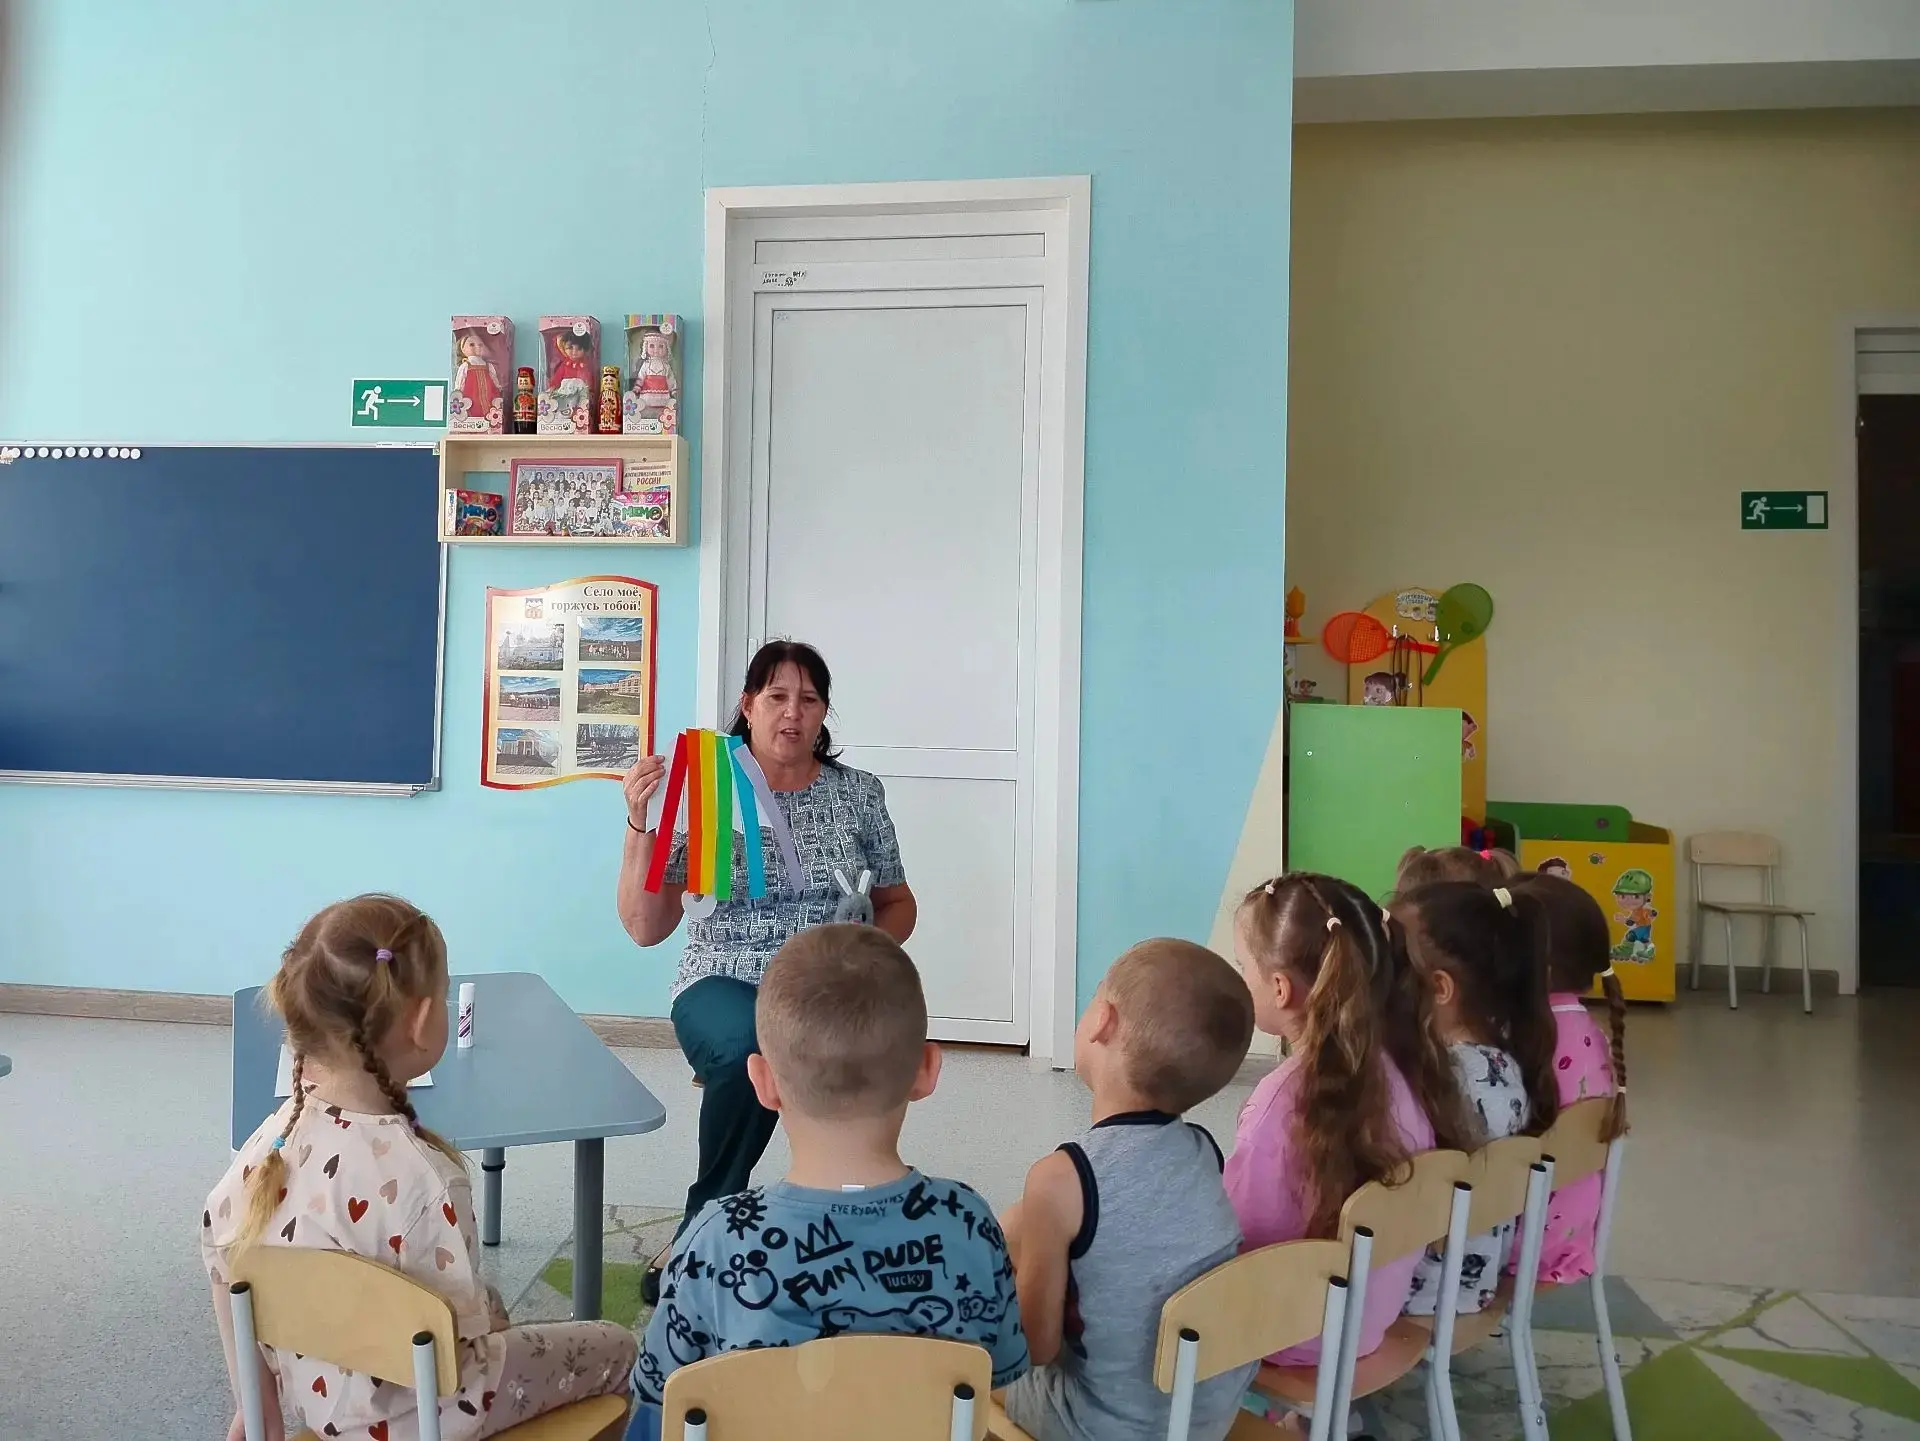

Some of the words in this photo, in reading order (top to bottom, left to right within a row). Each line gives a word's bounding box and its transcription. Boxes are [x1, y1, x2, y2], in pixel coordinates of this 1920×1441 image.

[453, 421, 476, 430] Весна
[540, 423, 565, 432] Весна
[626, 423, 650, 431] Весна
[636, 477, 662, 485] РОССИИ
[583, 585, 614, 597] Село
[617, 586, 642, 598] моё,
[551, 601, 600, 613] горжусь
[603, 600, 641, 611] тобой!
[830, 1203, 887, 1217] EVERYDAY
[782, 1257, 866, 1313] FUN
[862, 1233, 946, 1280] DUDE
[886, 1273, 926, 1287] lucky
